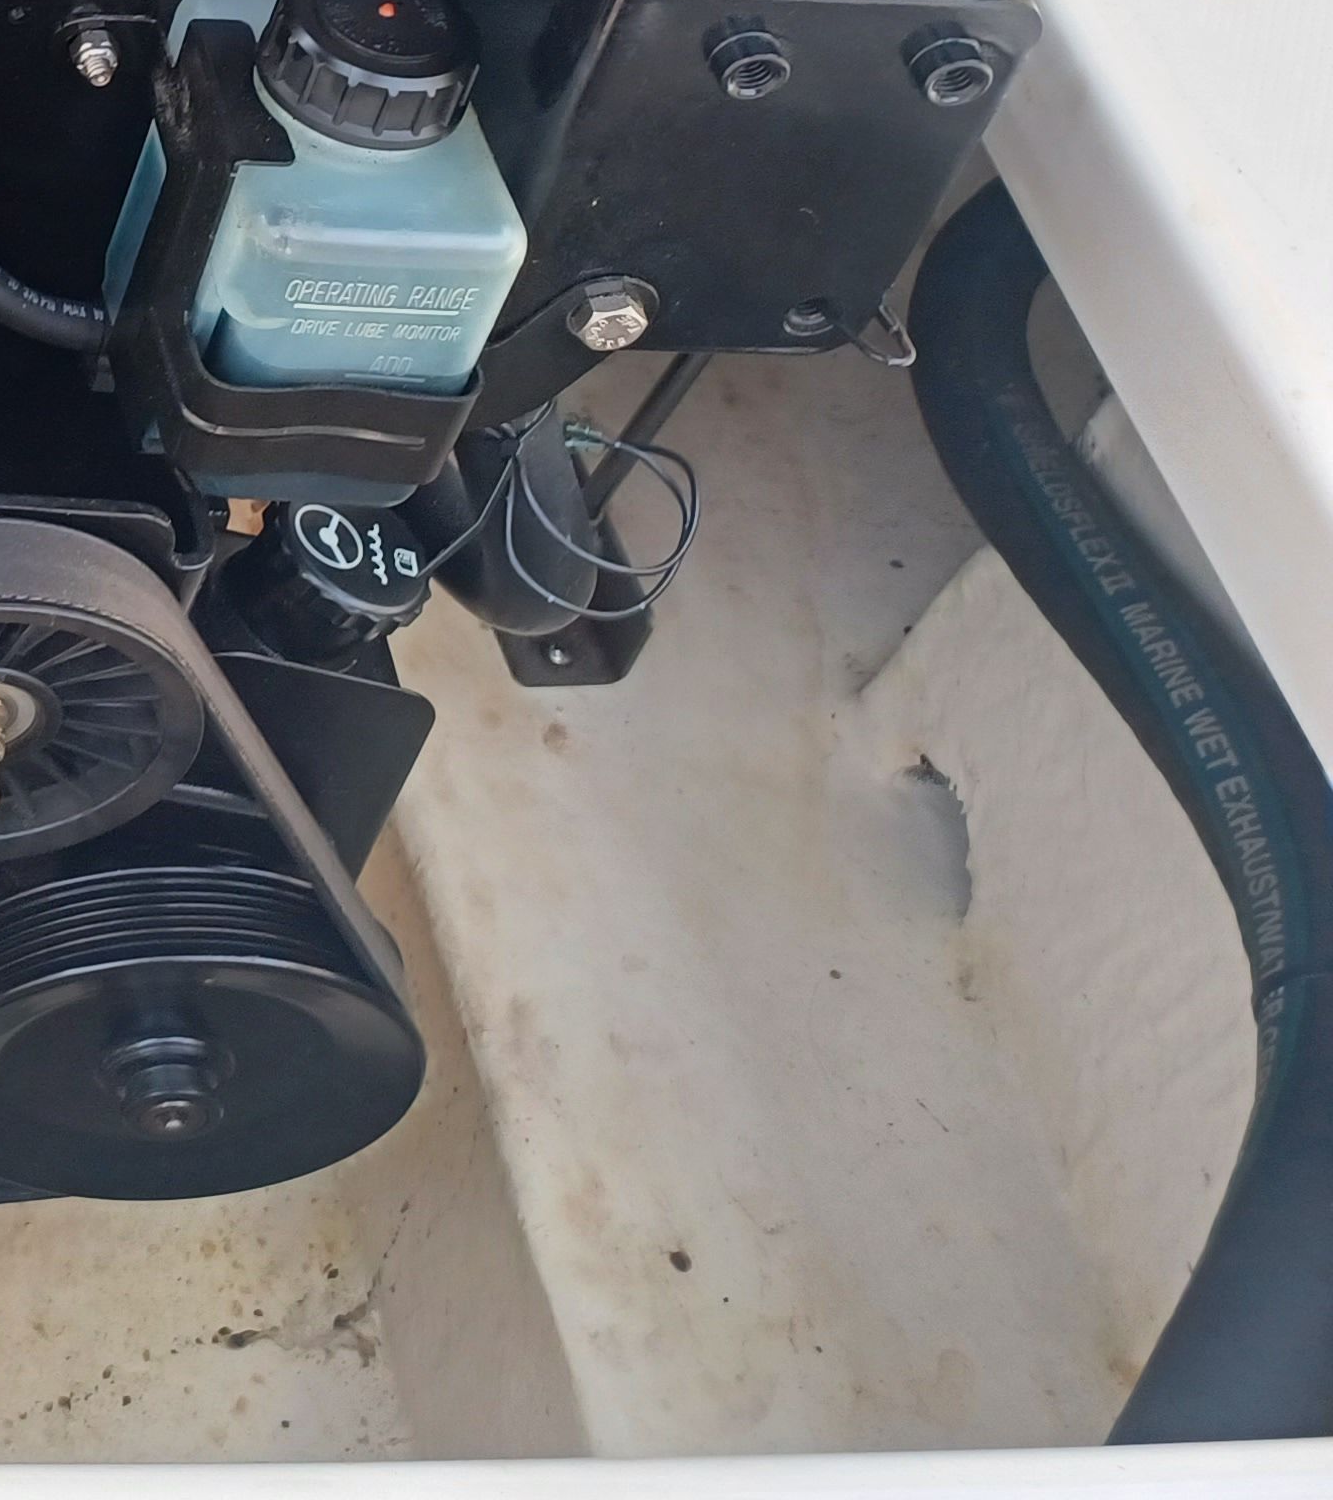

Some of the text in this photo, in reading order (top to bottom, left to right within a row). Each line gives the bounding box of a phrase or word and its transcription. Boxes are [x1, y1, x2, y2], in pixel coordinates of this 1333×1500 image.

[285, 277, 481, 310] OPERATING RANGE
[291, 319, 462, 342] DRIVE LUBE MONITOR
[1119, 599, 1204, 708] MARINE
[1182, 705, 1239, 773] WET
